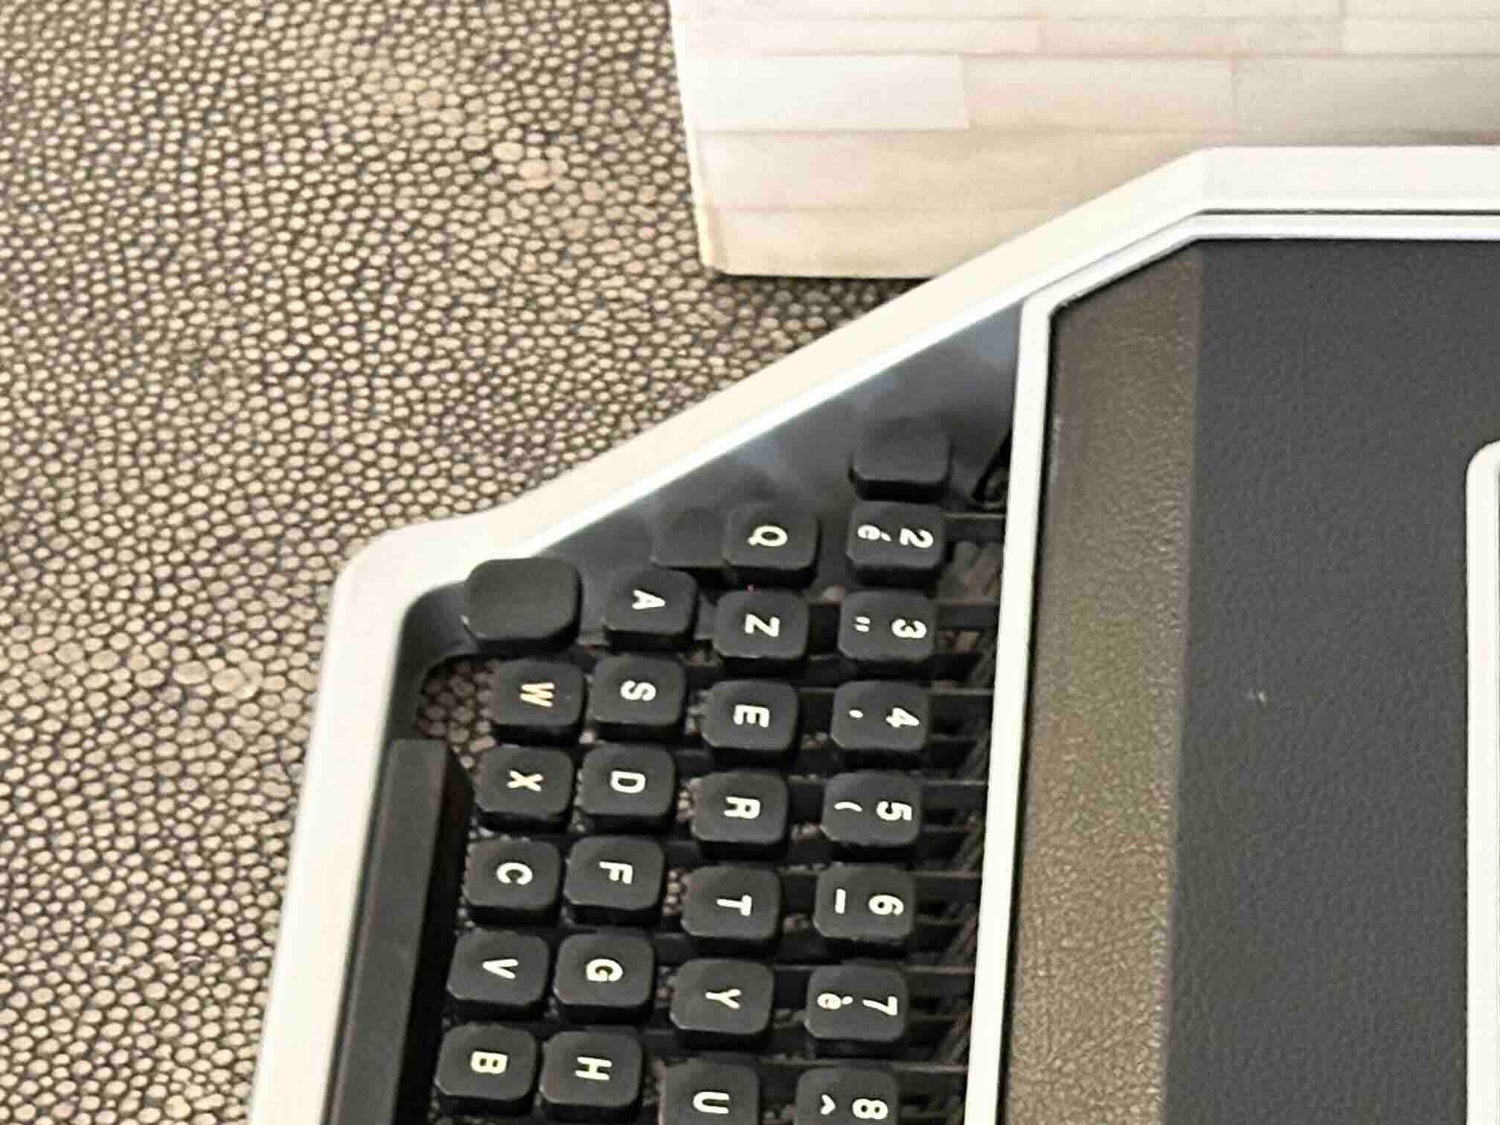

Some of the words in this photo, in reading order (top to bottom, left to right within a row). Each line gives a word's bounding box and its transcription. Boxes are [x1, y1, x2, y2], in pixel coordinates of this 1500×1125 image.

[747, 525, 788, 547] Q
[857, 524, 892, 542] é
[899, 527, 934, 549] 2
[631, 589, 666, 610] A
[744, 613, 780, 638] Z
[891, 618, 928, 639] 3
[519, 682, 555, 708] W
[620, 680, 657, 702] S
[732, 704, 770, 728] E
[885, 707, 920, 729] 4
[506, 770, 544, 792] X
[610, 770, 646, 794] D
[723, 796, 761, 820] R
[875, 800, 913, 822] 5
[496, 862, 533, 886] C
[598, 861, 634, 885] F
[716, 894, 753, 917] T
[868, 894, 904, 916] 6
[482, 958, 519, 980] V
[585, 958, 624, 983] G
[705, 988, 742, 1010] Y
[816, 993, 854, 1010] è
[862, 996, 898, 1016] 7
[470, 1051, 508, 1075] B
[574, 1056, 613, 1081] H
[692, 1091, 730, 1115] U
[852, 1098, 889, 1120] 8
